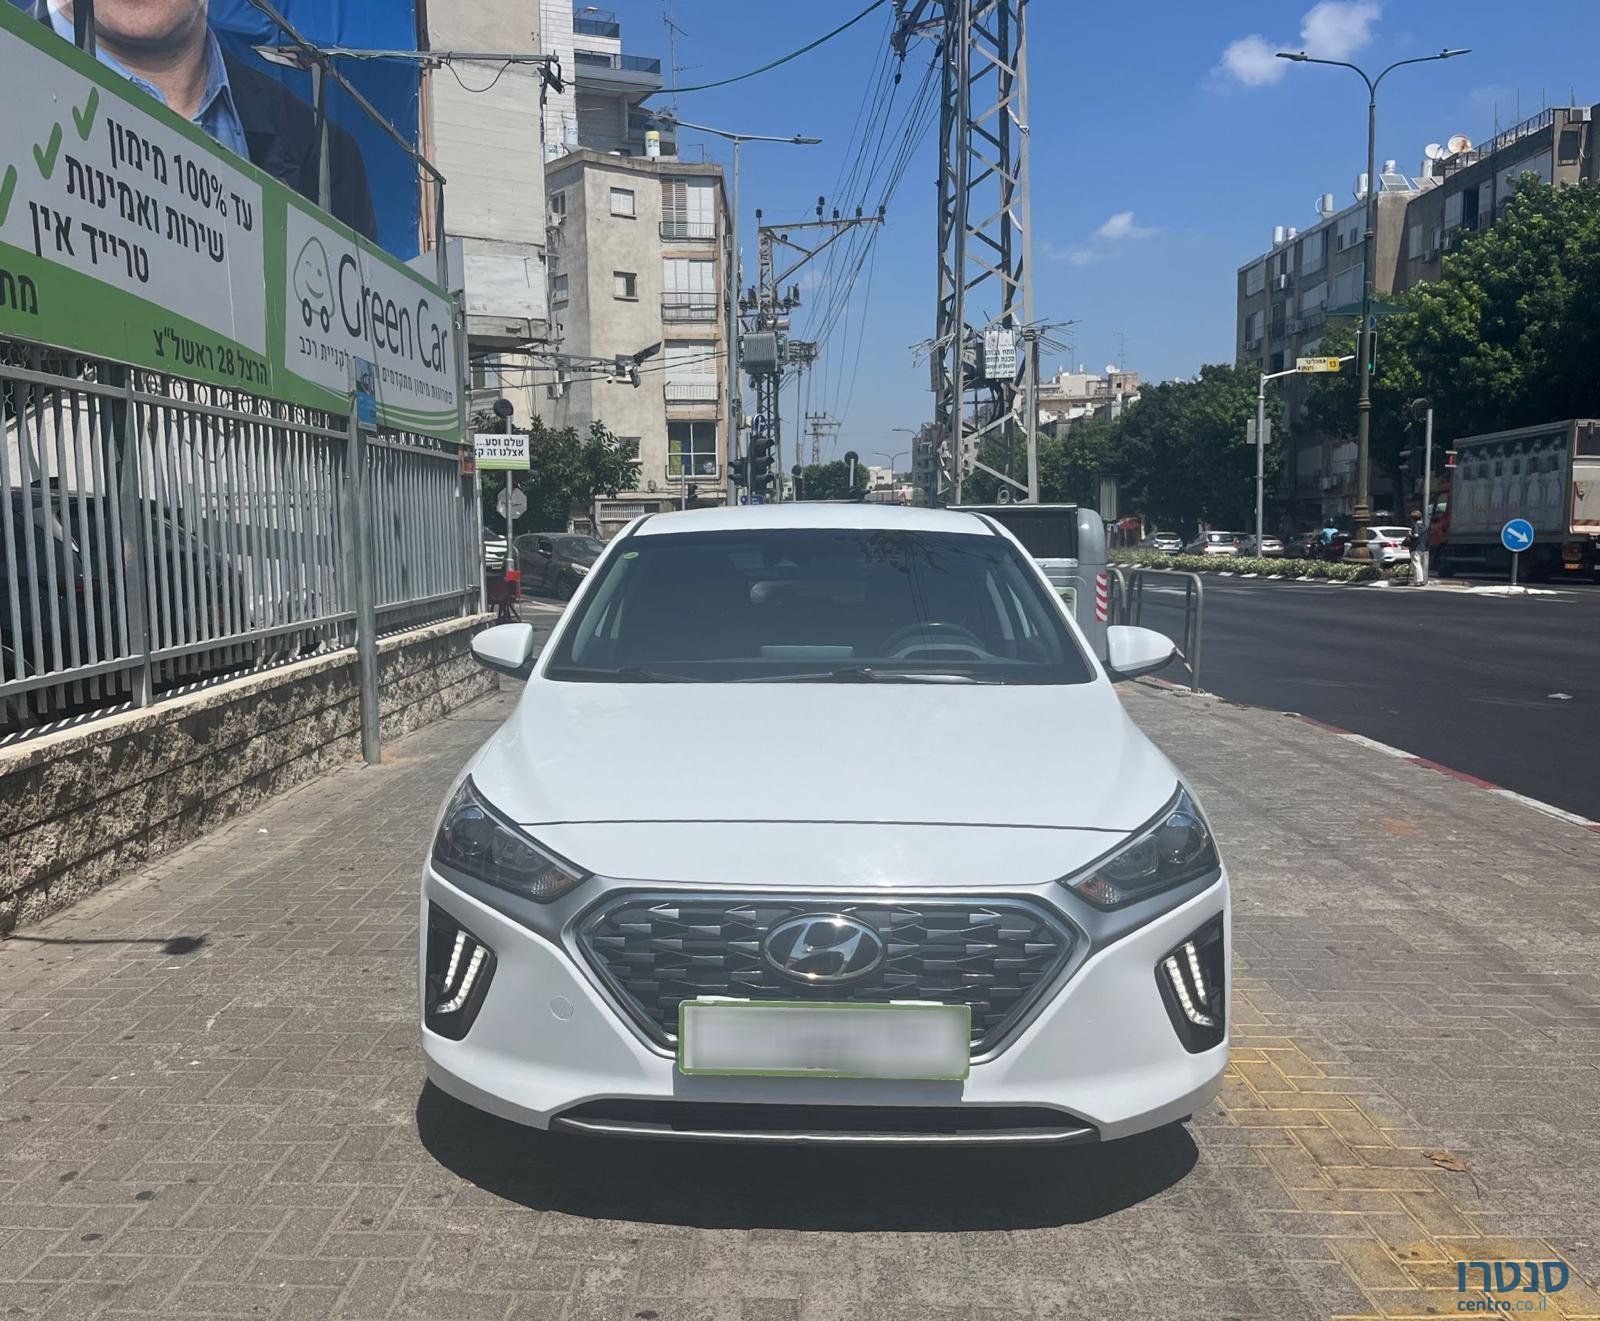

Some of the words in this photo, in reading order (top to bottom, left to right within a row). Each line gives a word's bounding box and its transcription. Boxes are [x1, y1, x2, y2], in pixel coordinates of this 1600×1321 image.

[107, 118, 167, 185] מימון
[65, 154, 160, 234] ואמינות
[174, 155, 227, 217] 100%
[29, 200, 75, 257] אין
[231, 192, 252, 231] עד
[166, 206, 224, 262] שירות
[81, 222, 149, 283] טרייד
[339, 254, 413, 360] Green
[417, 298, 448, 374] Car
[217, 345, 235, 376] 28
[299, 336, 318, 358] רכב
[321, 343, 350, 372] לקניית
[237, 350, 268, 386] הרצל
[382, 367, 413, 392] מתקדמים
[414, 377, 430, 397] מימון
[487, 448, 497, 457] זה
[499, 448, 524, 457] אצלנו
[504, 437, 524, 447] שלם
